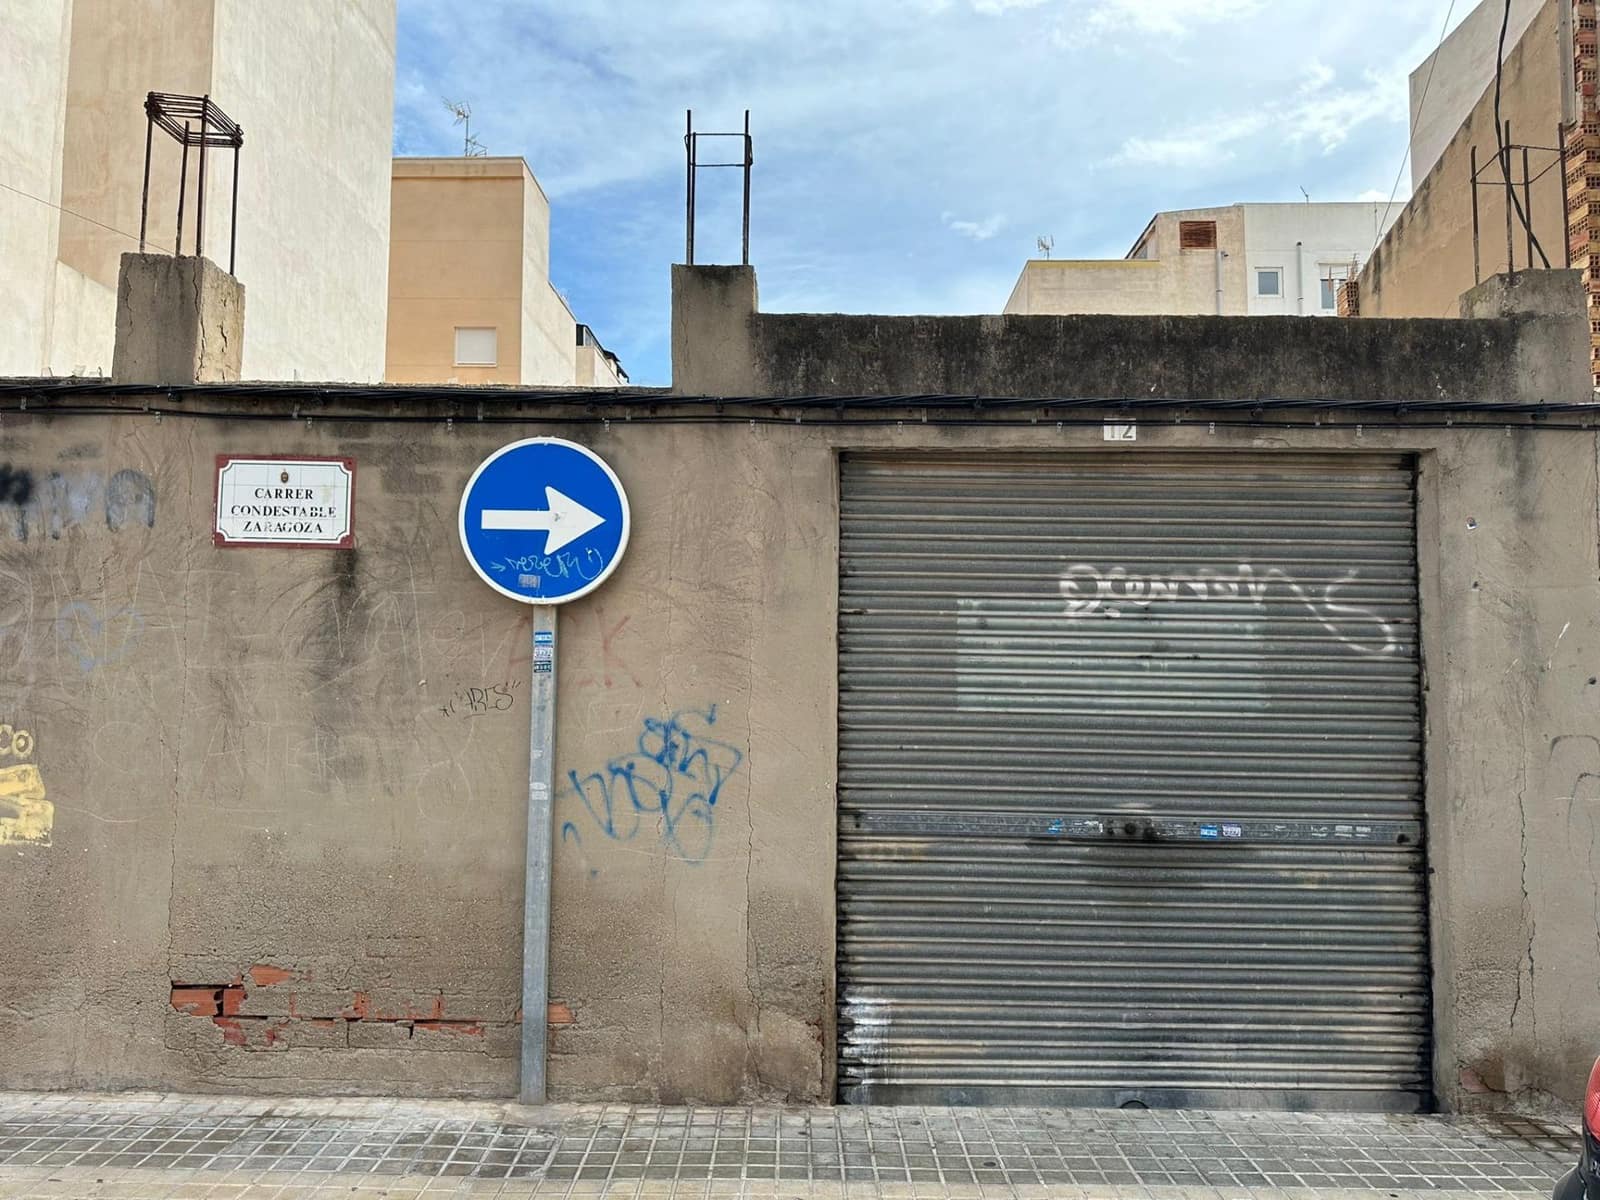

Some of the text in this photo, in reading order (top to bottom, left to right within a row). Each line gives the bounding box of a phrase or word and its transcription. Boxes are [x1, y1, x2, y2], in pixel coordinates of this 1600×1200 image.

[254, 487, 314, 500] CARRER
[230, 504, 337, 518] CONDESTABLE
[242, 520, 324, 534] ZARAGOZA
